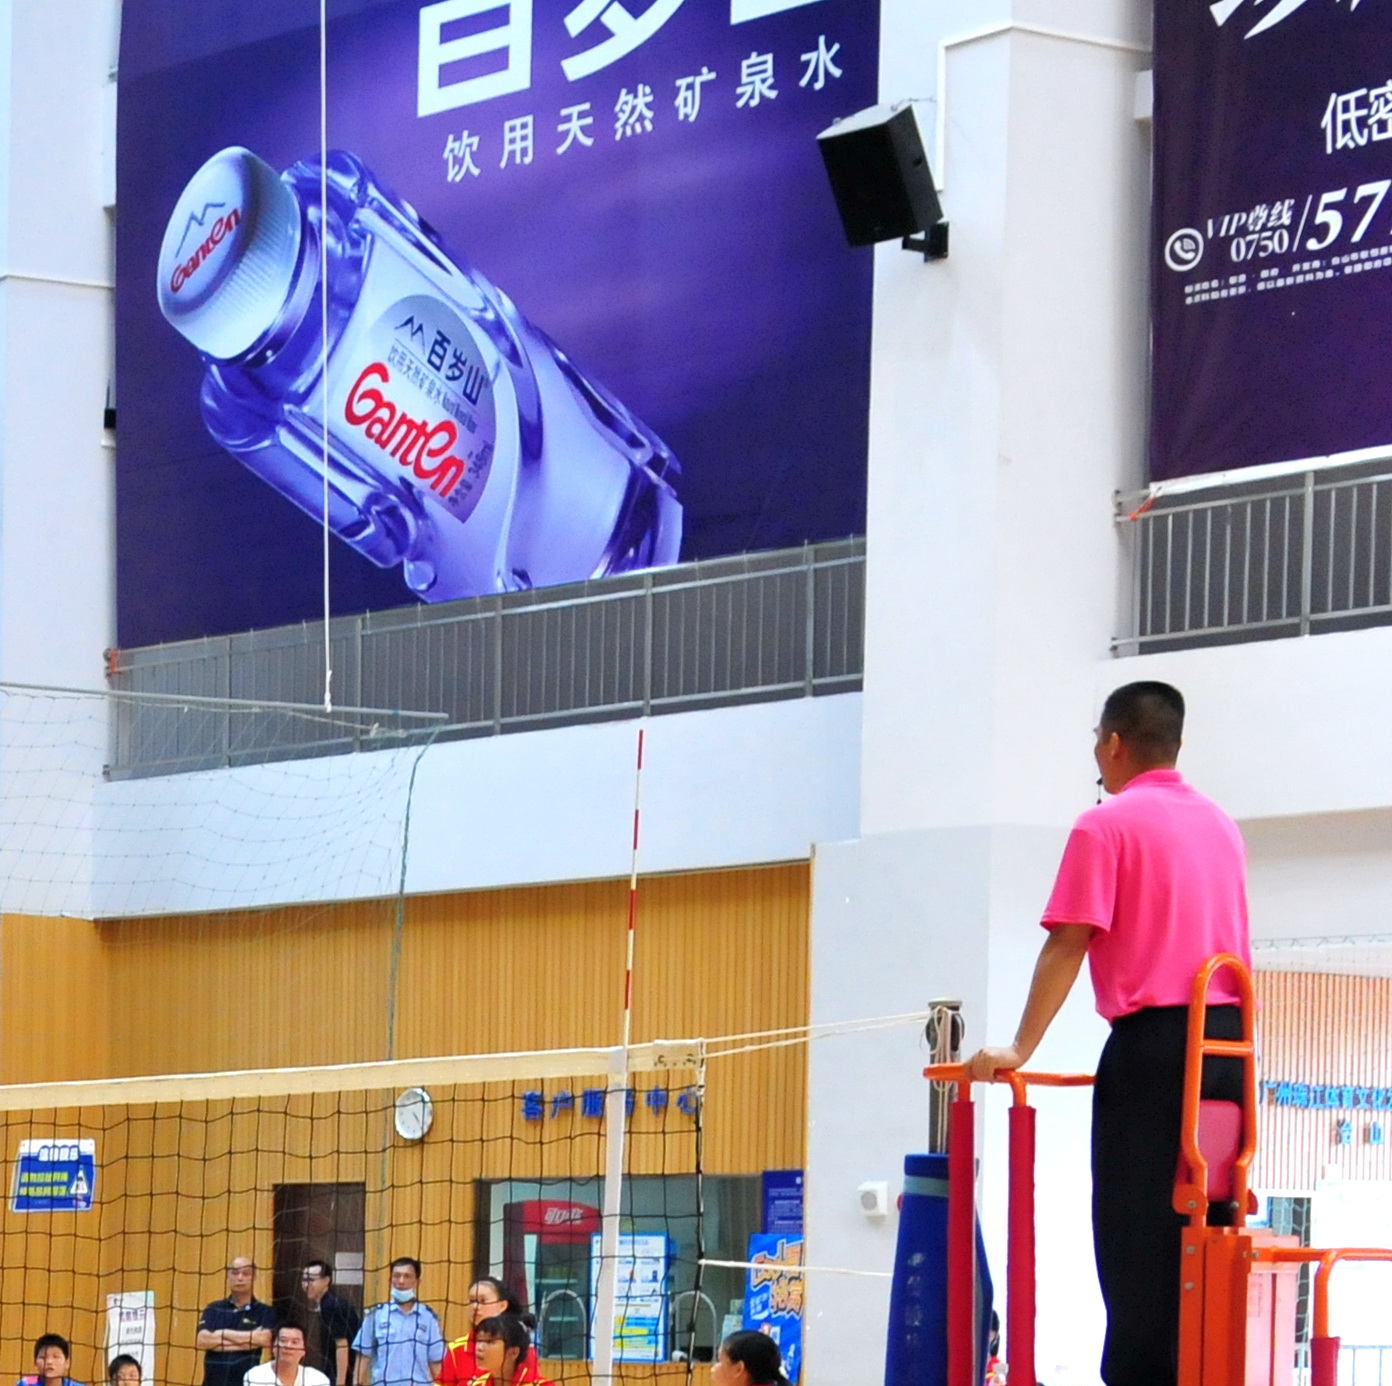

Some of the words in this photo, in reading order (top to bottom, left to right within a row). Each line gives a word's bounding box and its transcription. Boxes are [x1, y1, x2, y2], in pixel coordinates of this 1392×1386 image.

[442, 36, 844, 184] 饮用天然矿泉水
[1230, 228, 1290, 262] 0750
